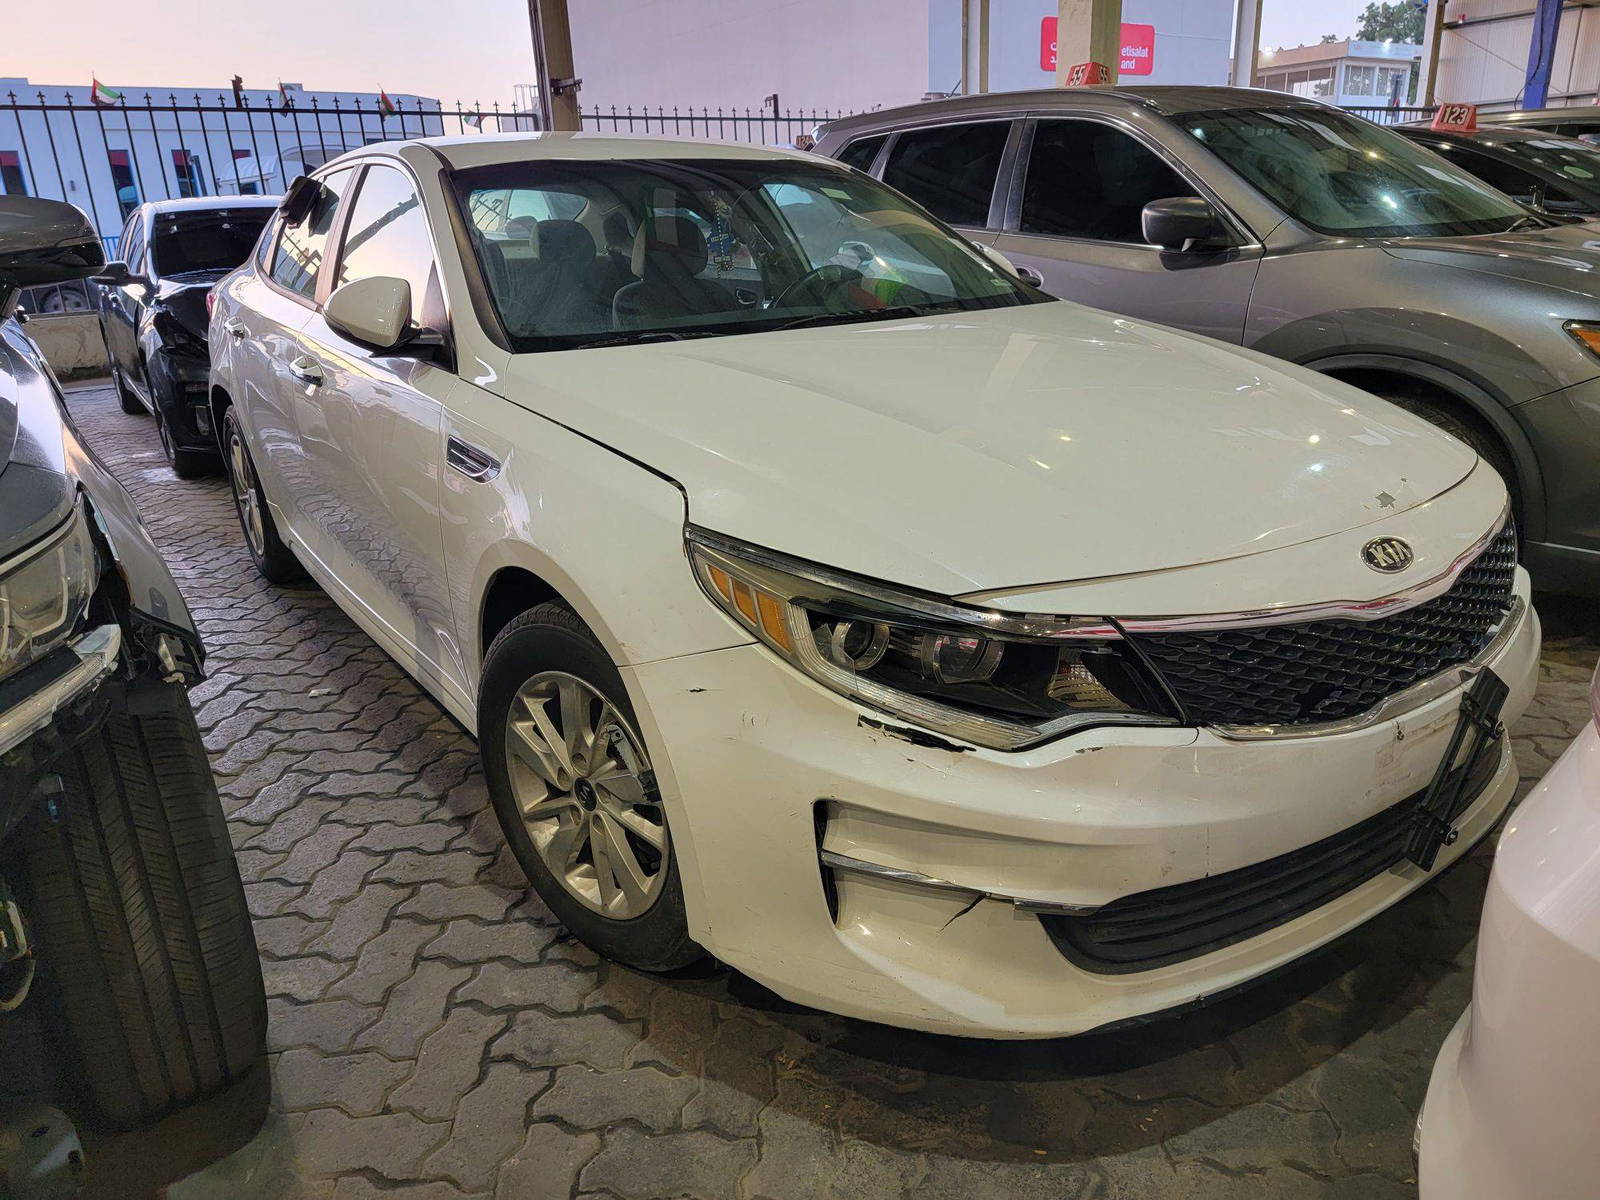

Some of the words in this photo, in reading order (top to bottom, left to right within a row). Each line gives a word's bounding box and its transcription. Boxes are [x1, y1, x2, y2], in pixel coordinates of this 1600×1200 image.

[1121, 46, 1148, 57] etisalat
[1120, 58, 1135, 69] and
[1070, 65, 1086, 86] 55
[1442, 106, 1468, 125] 123
[1369, 541, 1411, 567] KIA
